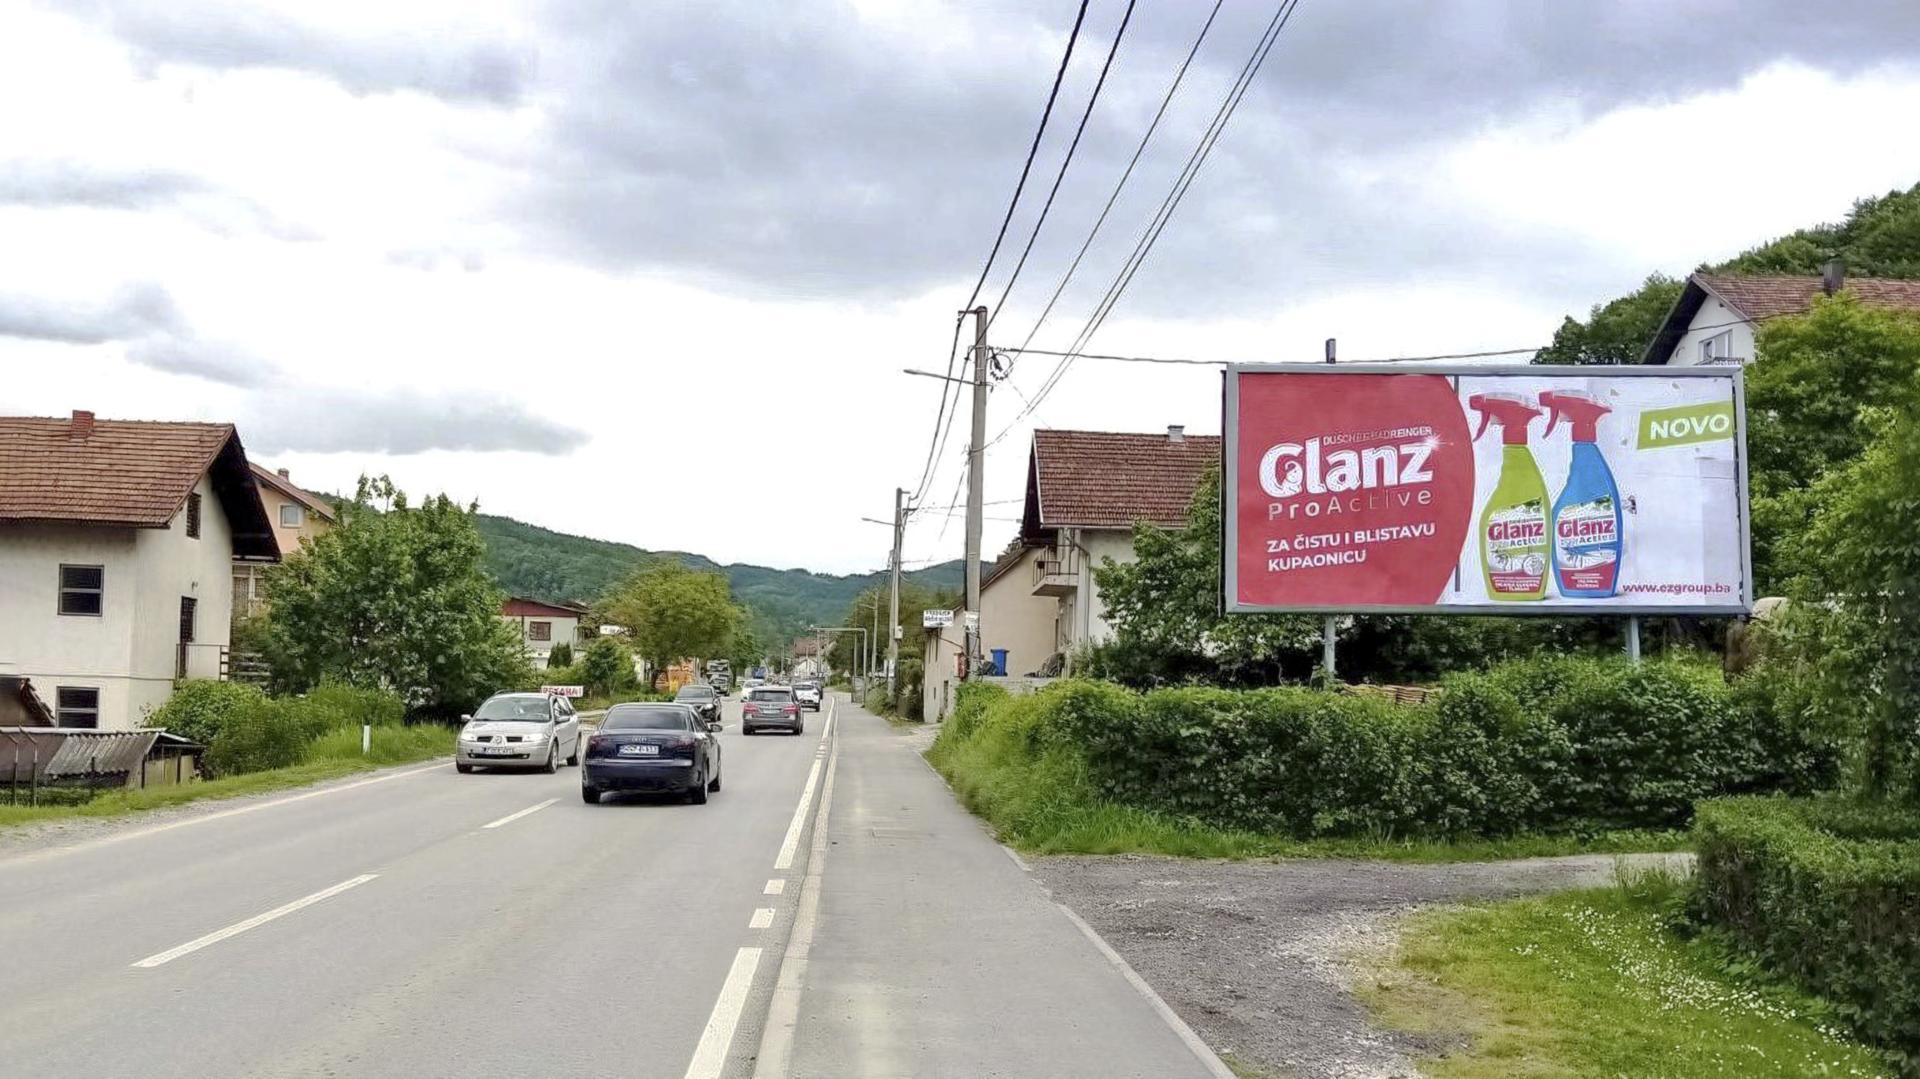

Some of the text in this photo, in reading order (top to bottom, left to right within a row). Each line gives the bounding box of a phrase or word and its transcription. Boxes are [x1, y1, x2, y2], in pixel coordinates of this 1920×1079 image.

[1650, 413, 1730, 441] NOVO
[1259, 436, 1434, 498] Glanz
[1268, 489, 1432, 521] ProActive
[1266, 522, 1436, 553] ZA ČISTU I BLISTAVU
[1488, 521, 1544, 540] Glanz
[1558, 519, 1614, 538] Glanz
[1268, 549, 1367, 572] KUPAONICU
[1622, 582, 1731, 595] www.ezgroup.ba
